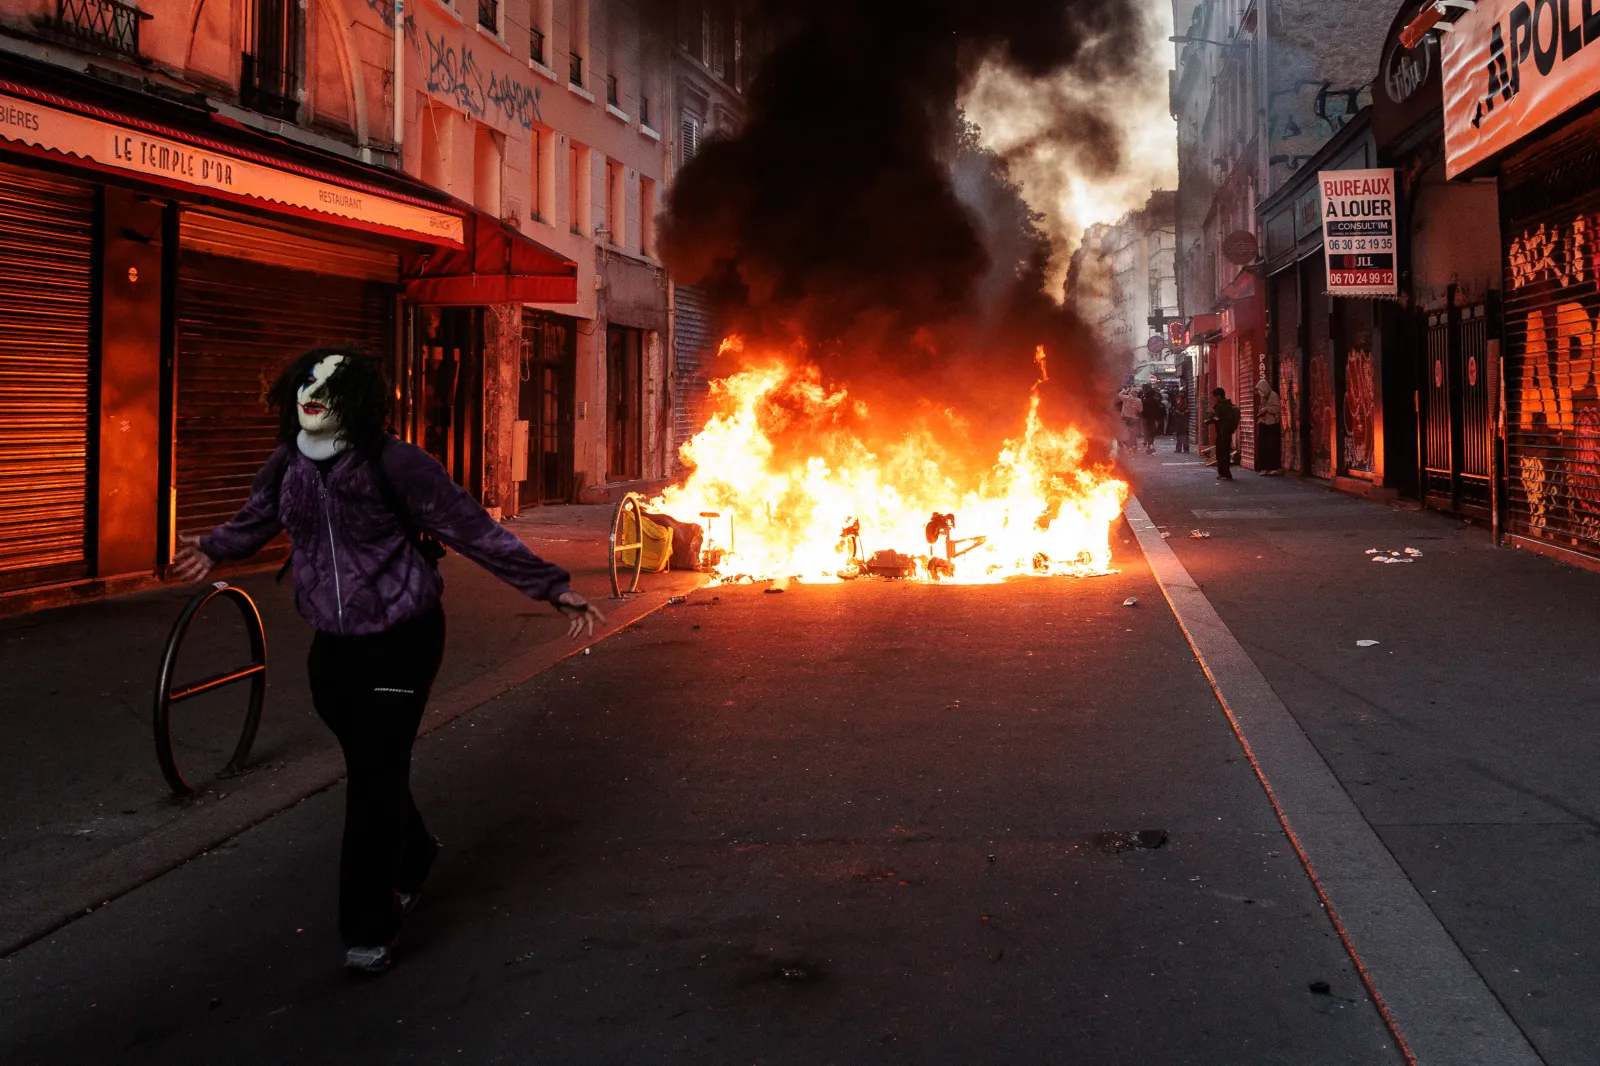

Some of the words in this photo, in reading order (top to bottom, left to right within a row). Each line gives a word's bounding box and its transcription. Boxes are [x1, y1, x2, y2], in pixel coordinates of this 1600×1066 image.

[114, 135, 133, 161] LE
[140, 141, 194, 177] TEMPLE
[202, 158, 232, 185] D'OR
[1324, 178, 1391, 197] BUREAUX
[318, 189, 362, 210] RESTAURANT
[1326, 197, 1337, 217] À
[1341, 200, 1391, 217] LOUER
[1337, 221, 1388, 230] CONSULT'IM
[1329, 240, 1339, 250] 06
[1342, 240, 1352, 250] 30
[1355, 239, 1366, 249] 32
[1369, 239, 1379, 249] 19
[1381, 239, 1392, 249] 35
[1356, 256, 1373, 267] JLL
[1330, 273, 1341, 284] 06
[1344, 273, 1354, 284] 70
[1356, 272, 1368, 284] 24
[1369, 272, 1380, 284] 99
[1382, 271, 1393, 283] 12
[1521, 302, 1600, 431] AP
